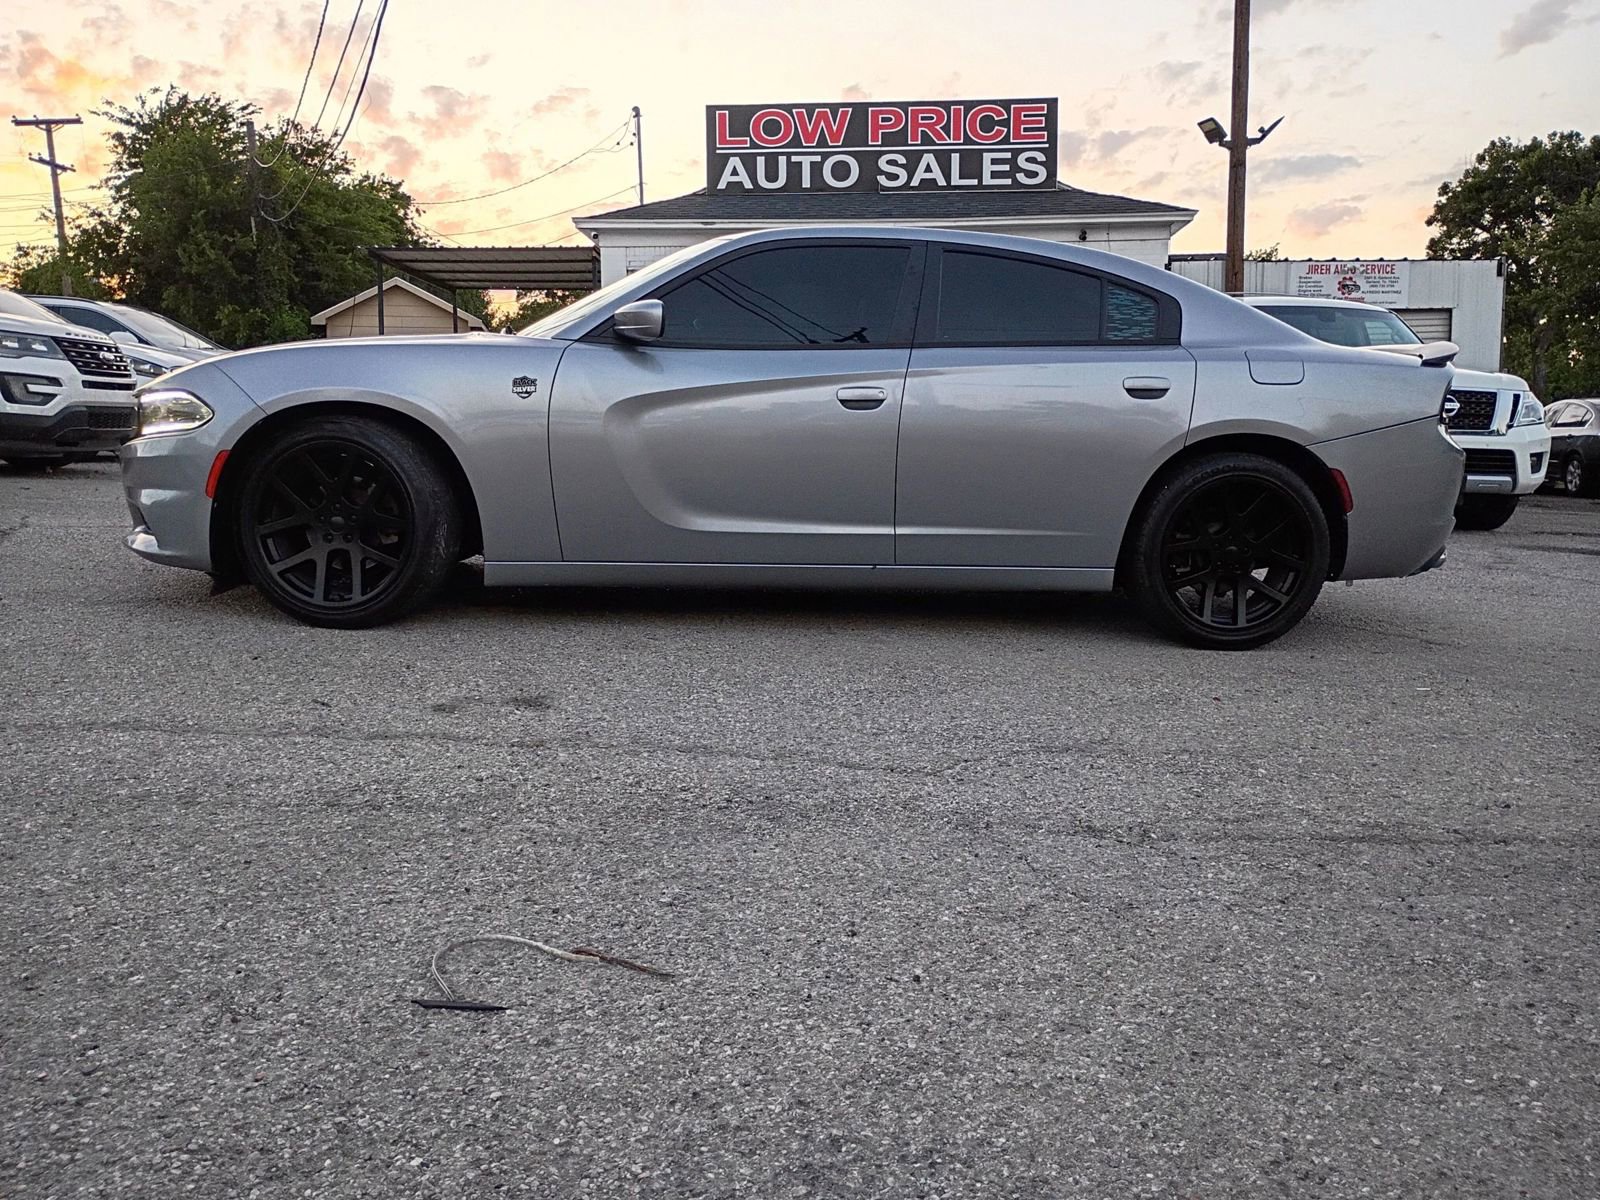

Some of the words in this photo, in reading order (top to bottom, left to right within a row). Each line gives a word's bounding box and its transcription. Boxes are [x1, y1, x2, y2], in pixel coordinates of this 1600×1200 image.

[715, 107, 852, 148] LOW
[868, 103, 1048, 145] PRICE
[716, 154, 859, 190] AUTO
[877, 150, 1048, 188] SALES
[1306, 264, 1331, 275] JIREH
